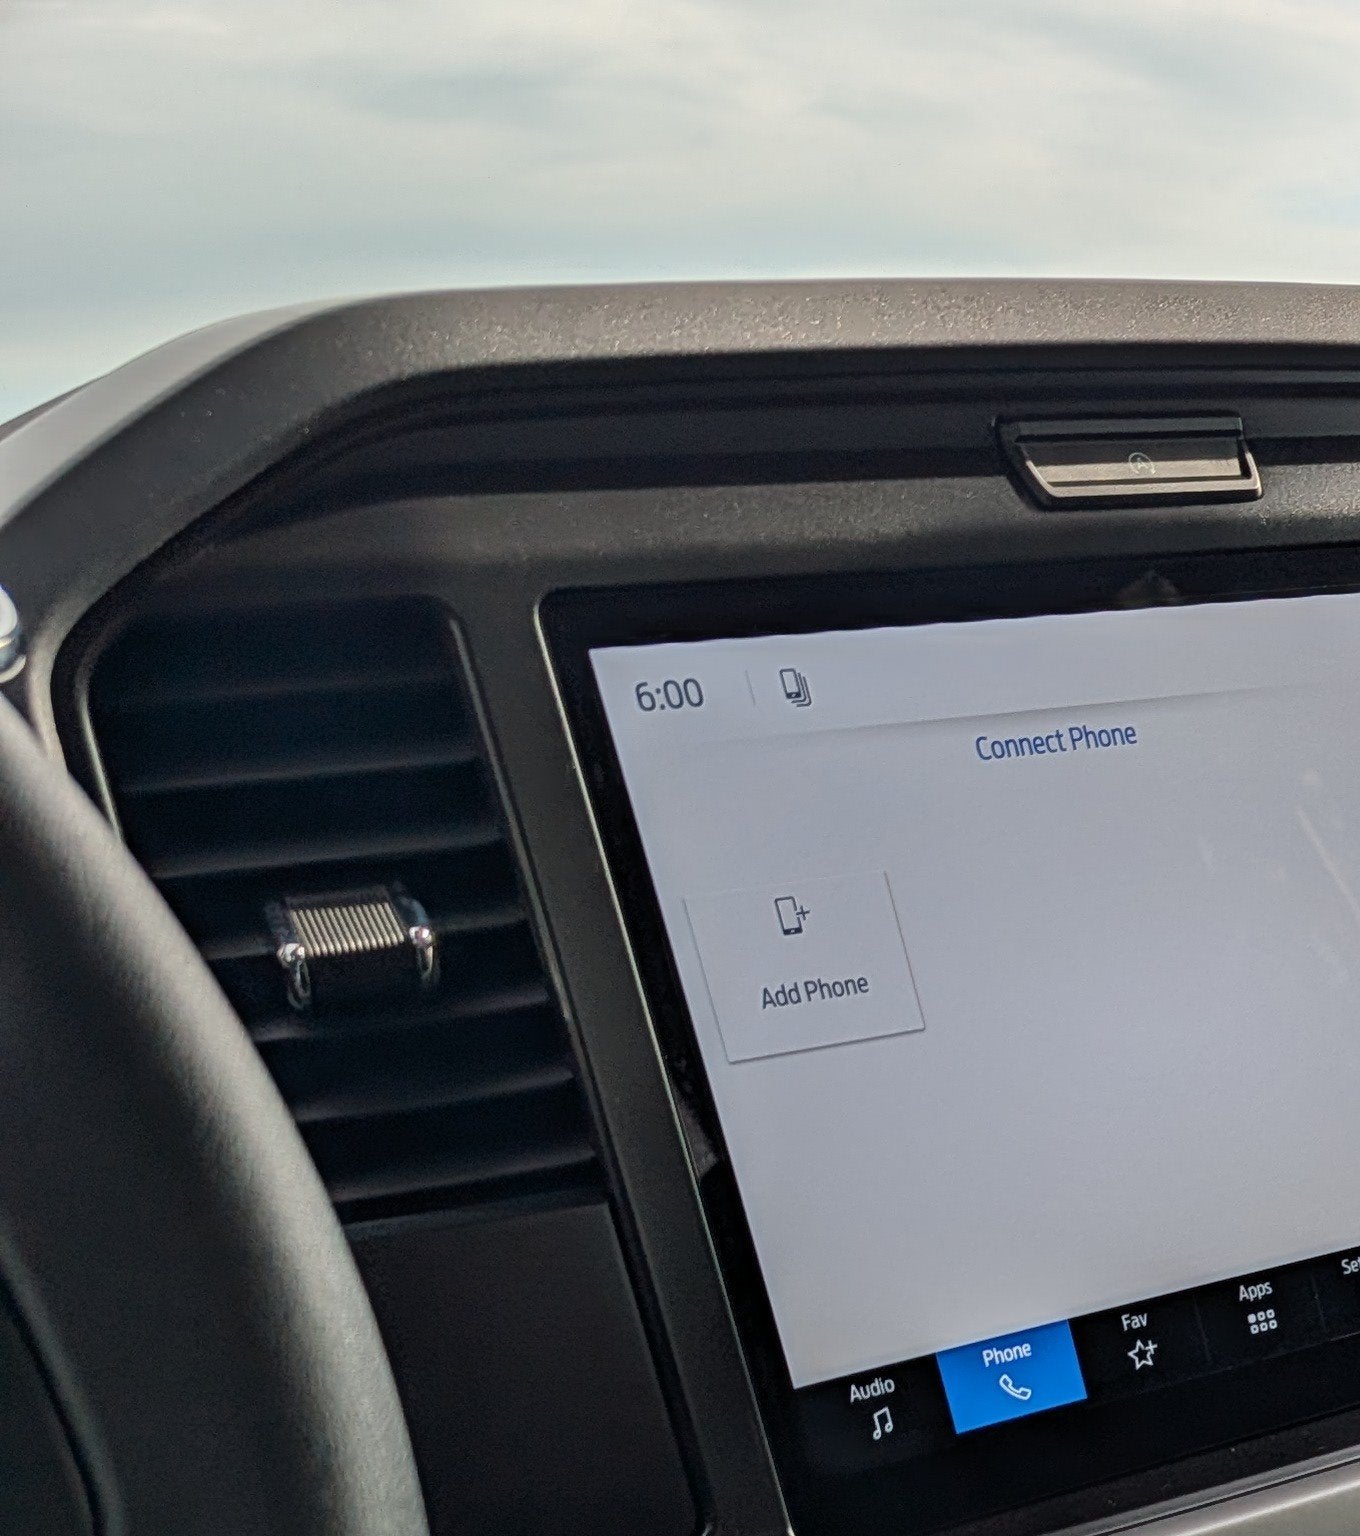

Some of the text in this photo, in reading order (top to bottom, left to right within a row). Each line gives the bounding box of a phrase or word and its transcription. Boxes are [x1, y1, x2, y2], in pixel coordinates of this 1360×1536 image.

[634, 676, 705, 712] 6:00
[974, 721, 1138, 761] Connect Phone
[760, 973, 870, 1011] Add Phone
[1237, 1280, 1274, 1302] Apps
[1121, 1312, 1149, 1332] Fav
[982, 1342, 1032, 1368] Phone
[849, 1376, 896, 1403] Audio
